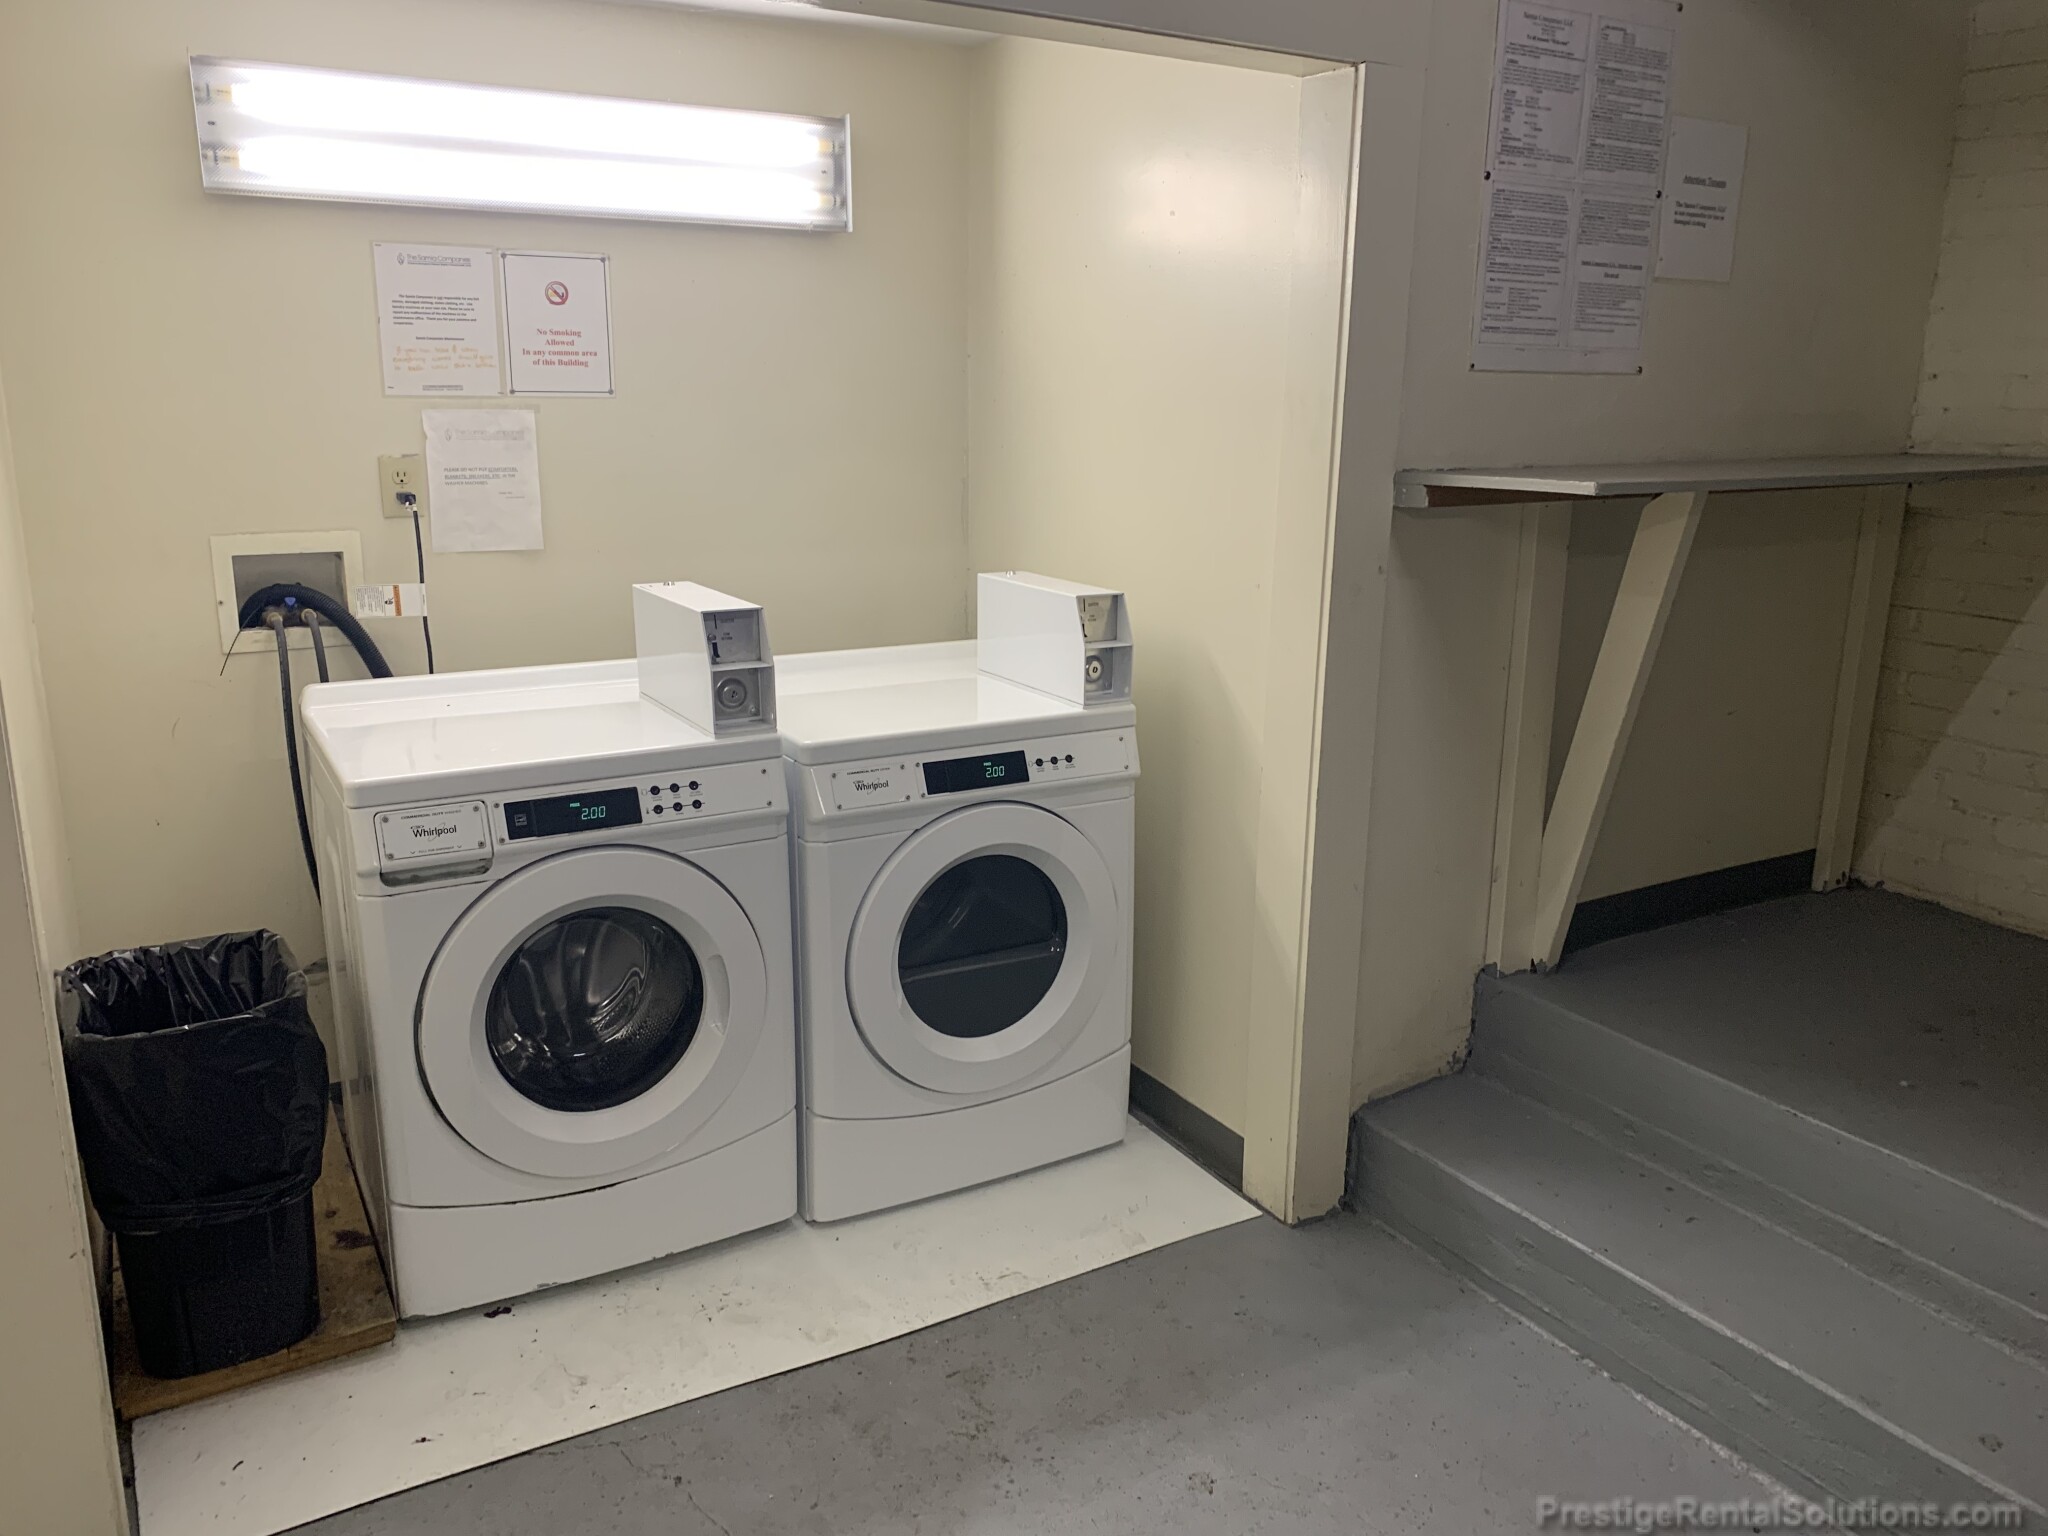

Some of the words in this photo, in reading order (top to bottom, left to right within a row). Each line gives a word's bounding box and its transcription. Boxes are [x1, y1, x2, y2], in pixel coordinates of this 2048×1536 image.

[549, 328, 582, 338] Smoking
[557, 359, 589, 368] Building
[985, 765, 1005, 778] 2.00
[854, 780, 889, 792] Whirlpool
[581, 805, 606, 820] 2.00
[412, 825, 457, 838] Whirlpool
